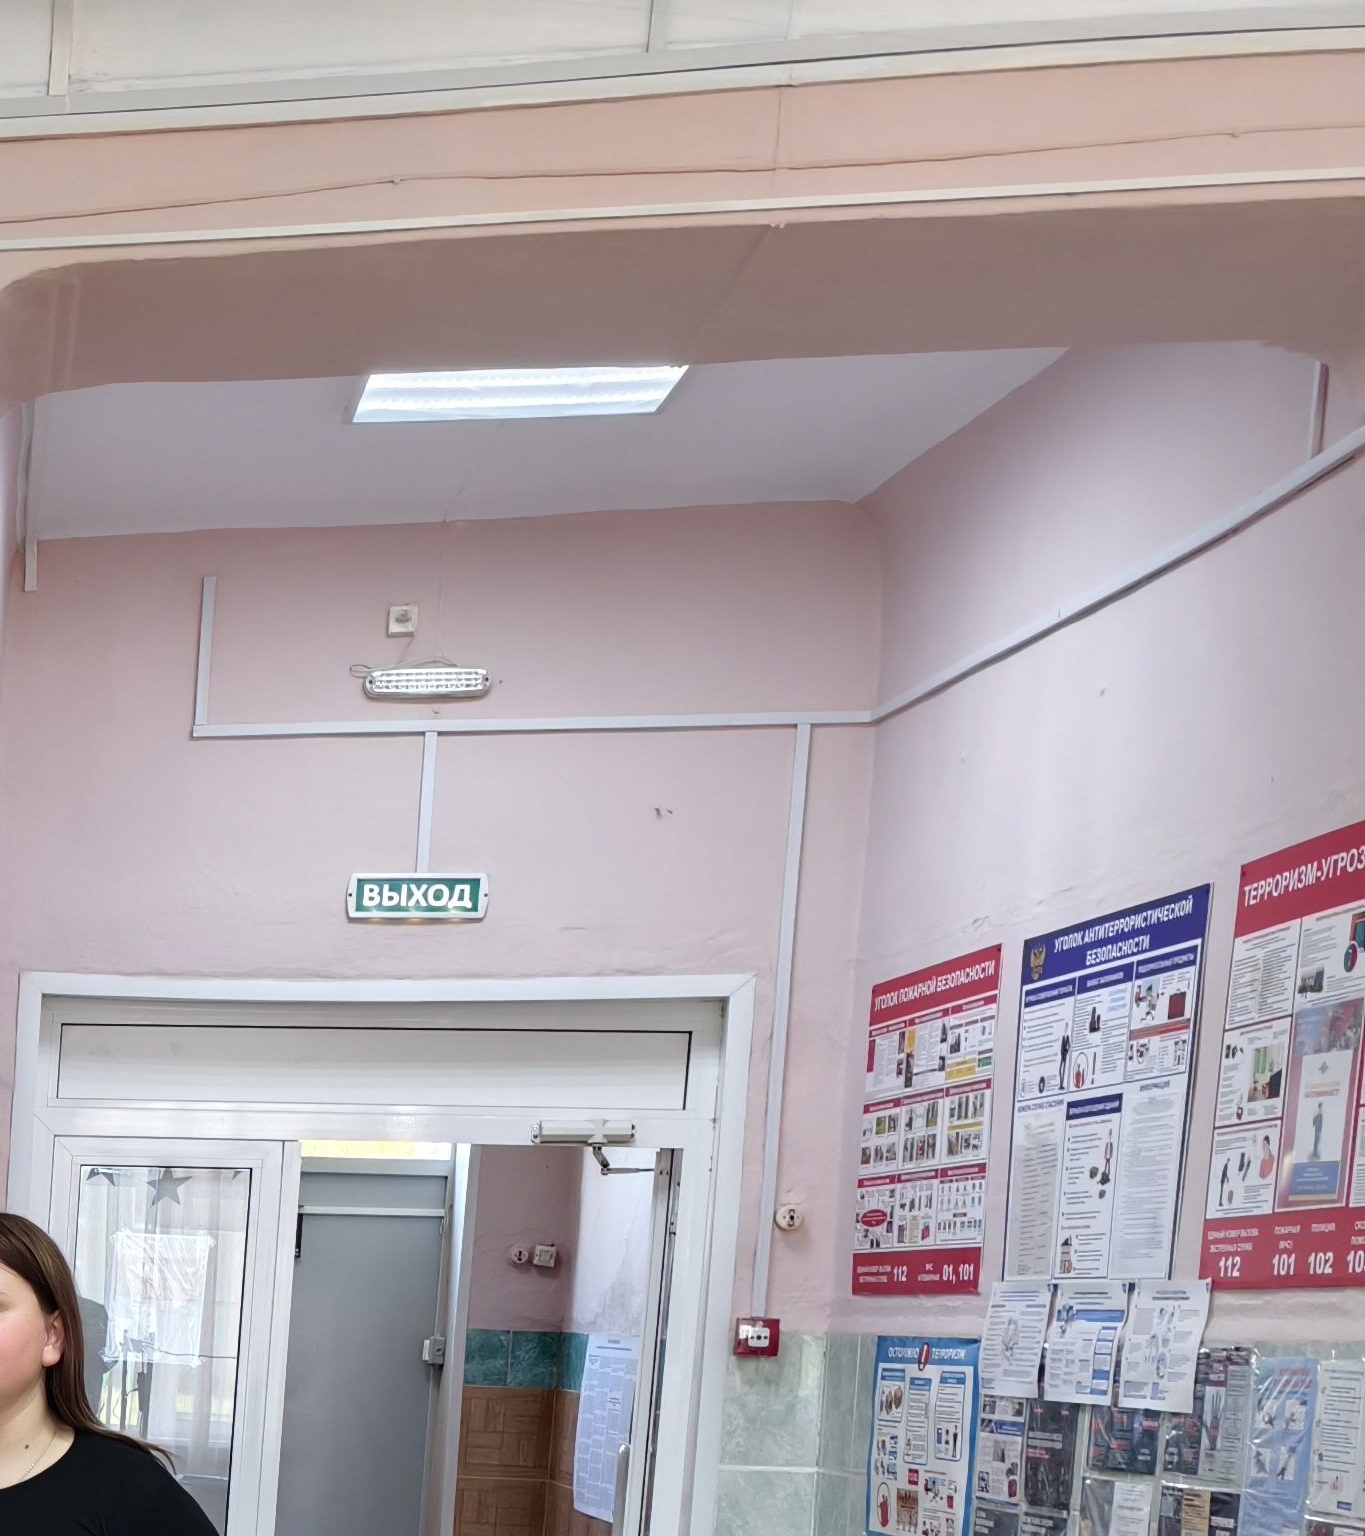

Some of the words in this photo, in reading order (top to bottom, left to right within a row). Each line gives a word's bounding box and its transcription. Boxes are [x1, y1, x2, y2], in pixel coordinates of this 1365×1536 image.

[362, 883, 472, 909] ВЫХОД
[1054, 929, 1083, 953] УГОЛОК
[1084, 895, 1194, 944] АНТИТЕРРОРИСТИЧЕСКОЙ
[1086, 934, 1150, 966] БЕЗОПАСНОСТИ
[874, 990, 898, 1011] УГОЛОК
[899, 976, 936, 1004] ПОЖАРНОЙ
[937, 960, 995, 992] БЕЗОПАСНОСТИ
[893, 1265, 907, 1281] 112
[1219, 1256, 1241, 1277] 112
[1272, 1253, 1296, 1276] 101
[1308, 1251, 1334, 1275] 102
[1347, 1250, 1365, 1273] 10
[942, 1264, 956, 1284] 01,
[958, 1263, 974, 1281] 101
